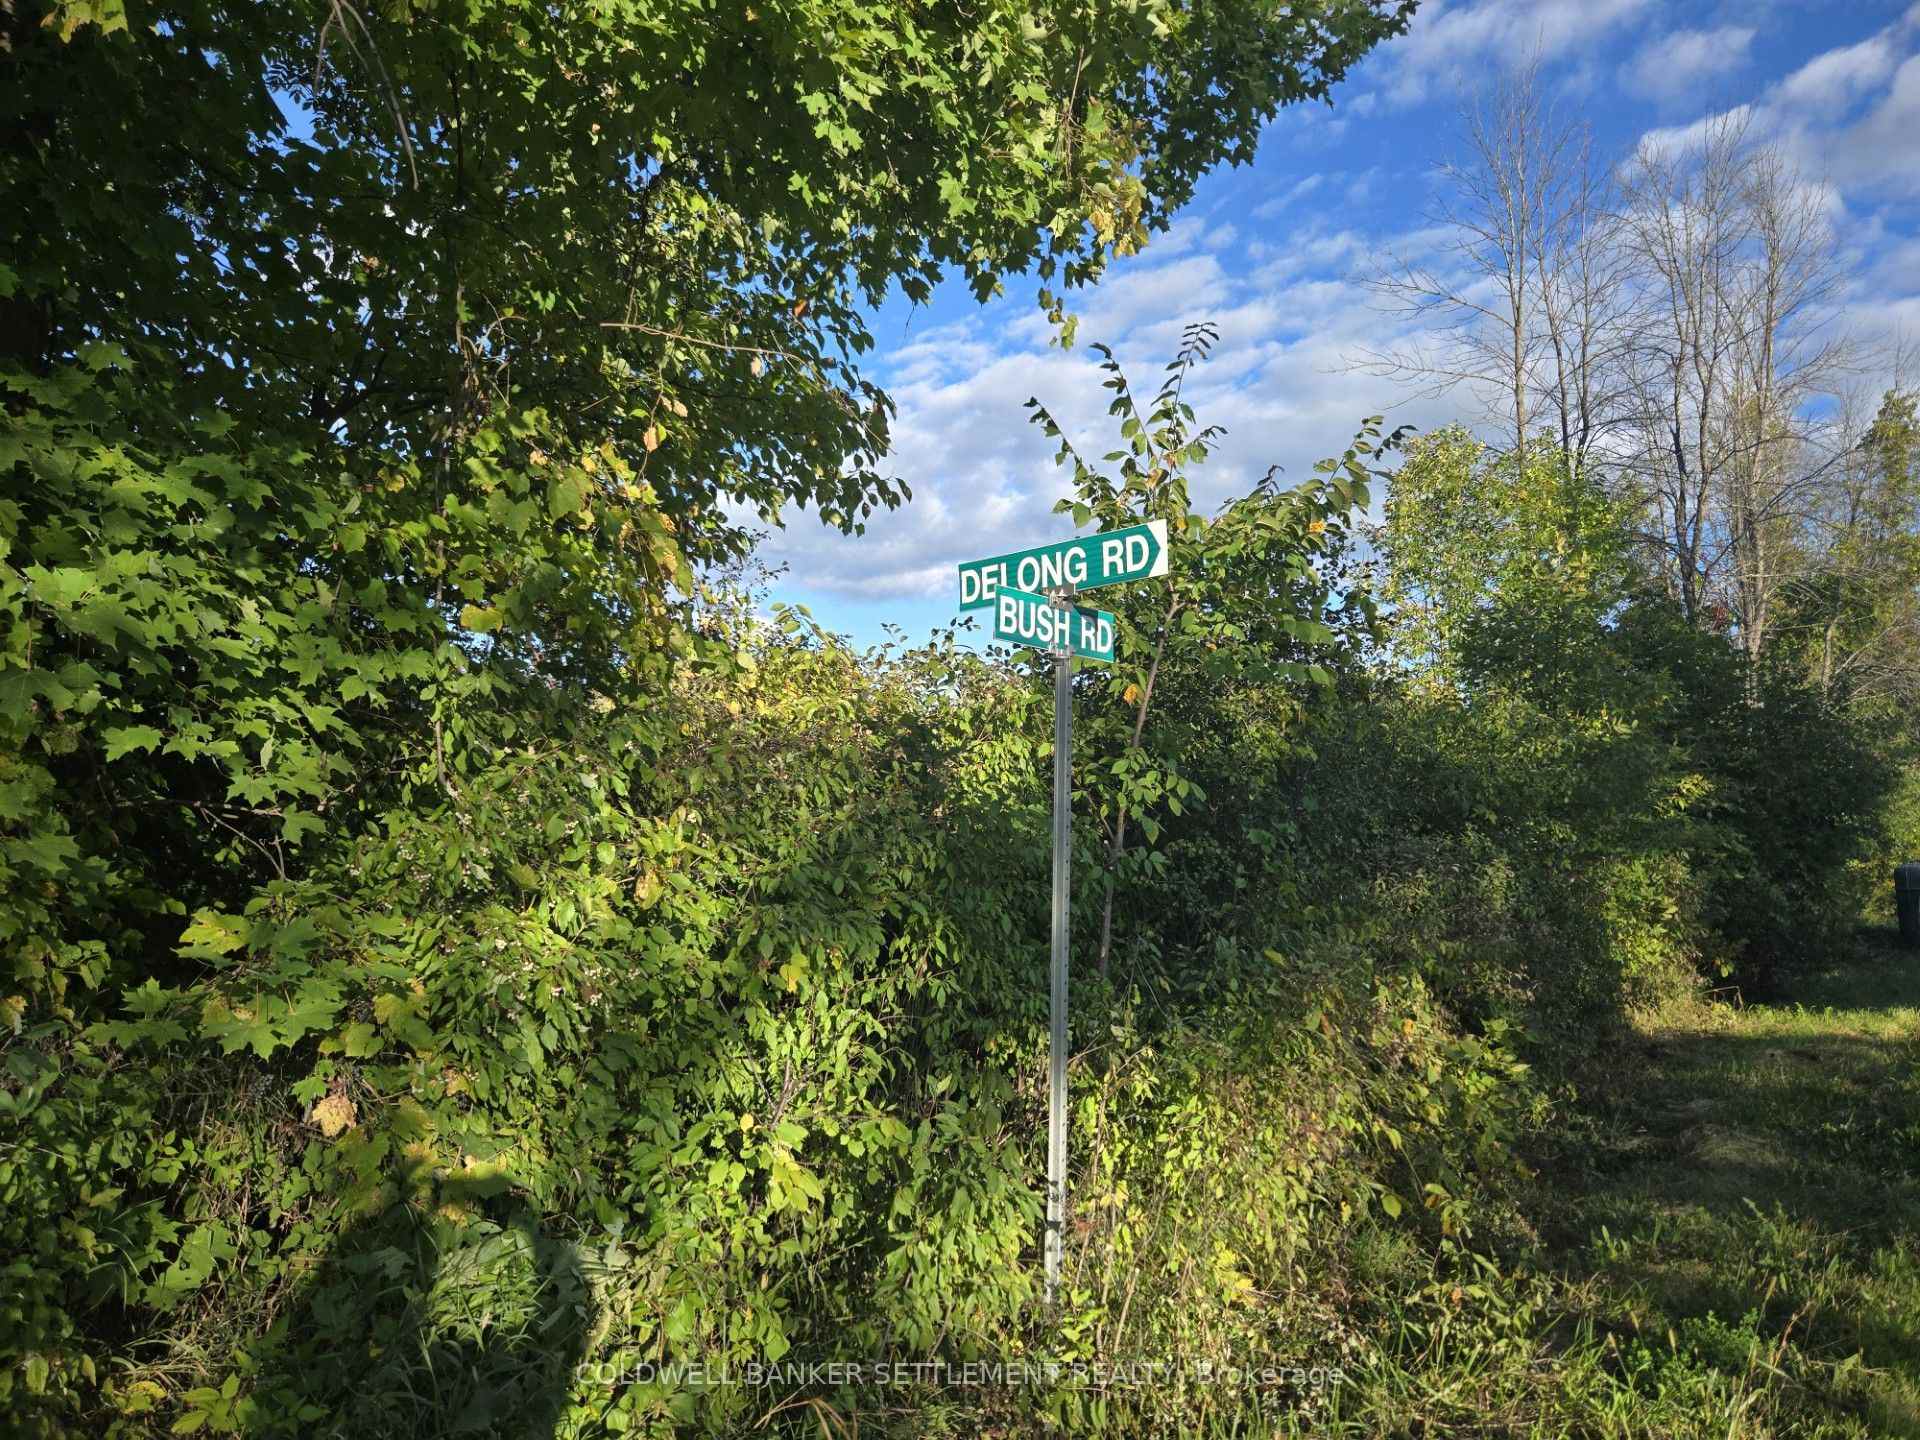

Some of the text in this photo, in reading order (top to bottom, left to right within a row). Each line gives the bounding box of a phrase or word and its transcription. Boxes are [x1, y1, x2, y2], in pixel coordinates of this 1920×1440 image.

[1103, 535, 1149, 577] RD
[999, 595, 1113, 653] BUSH RD
